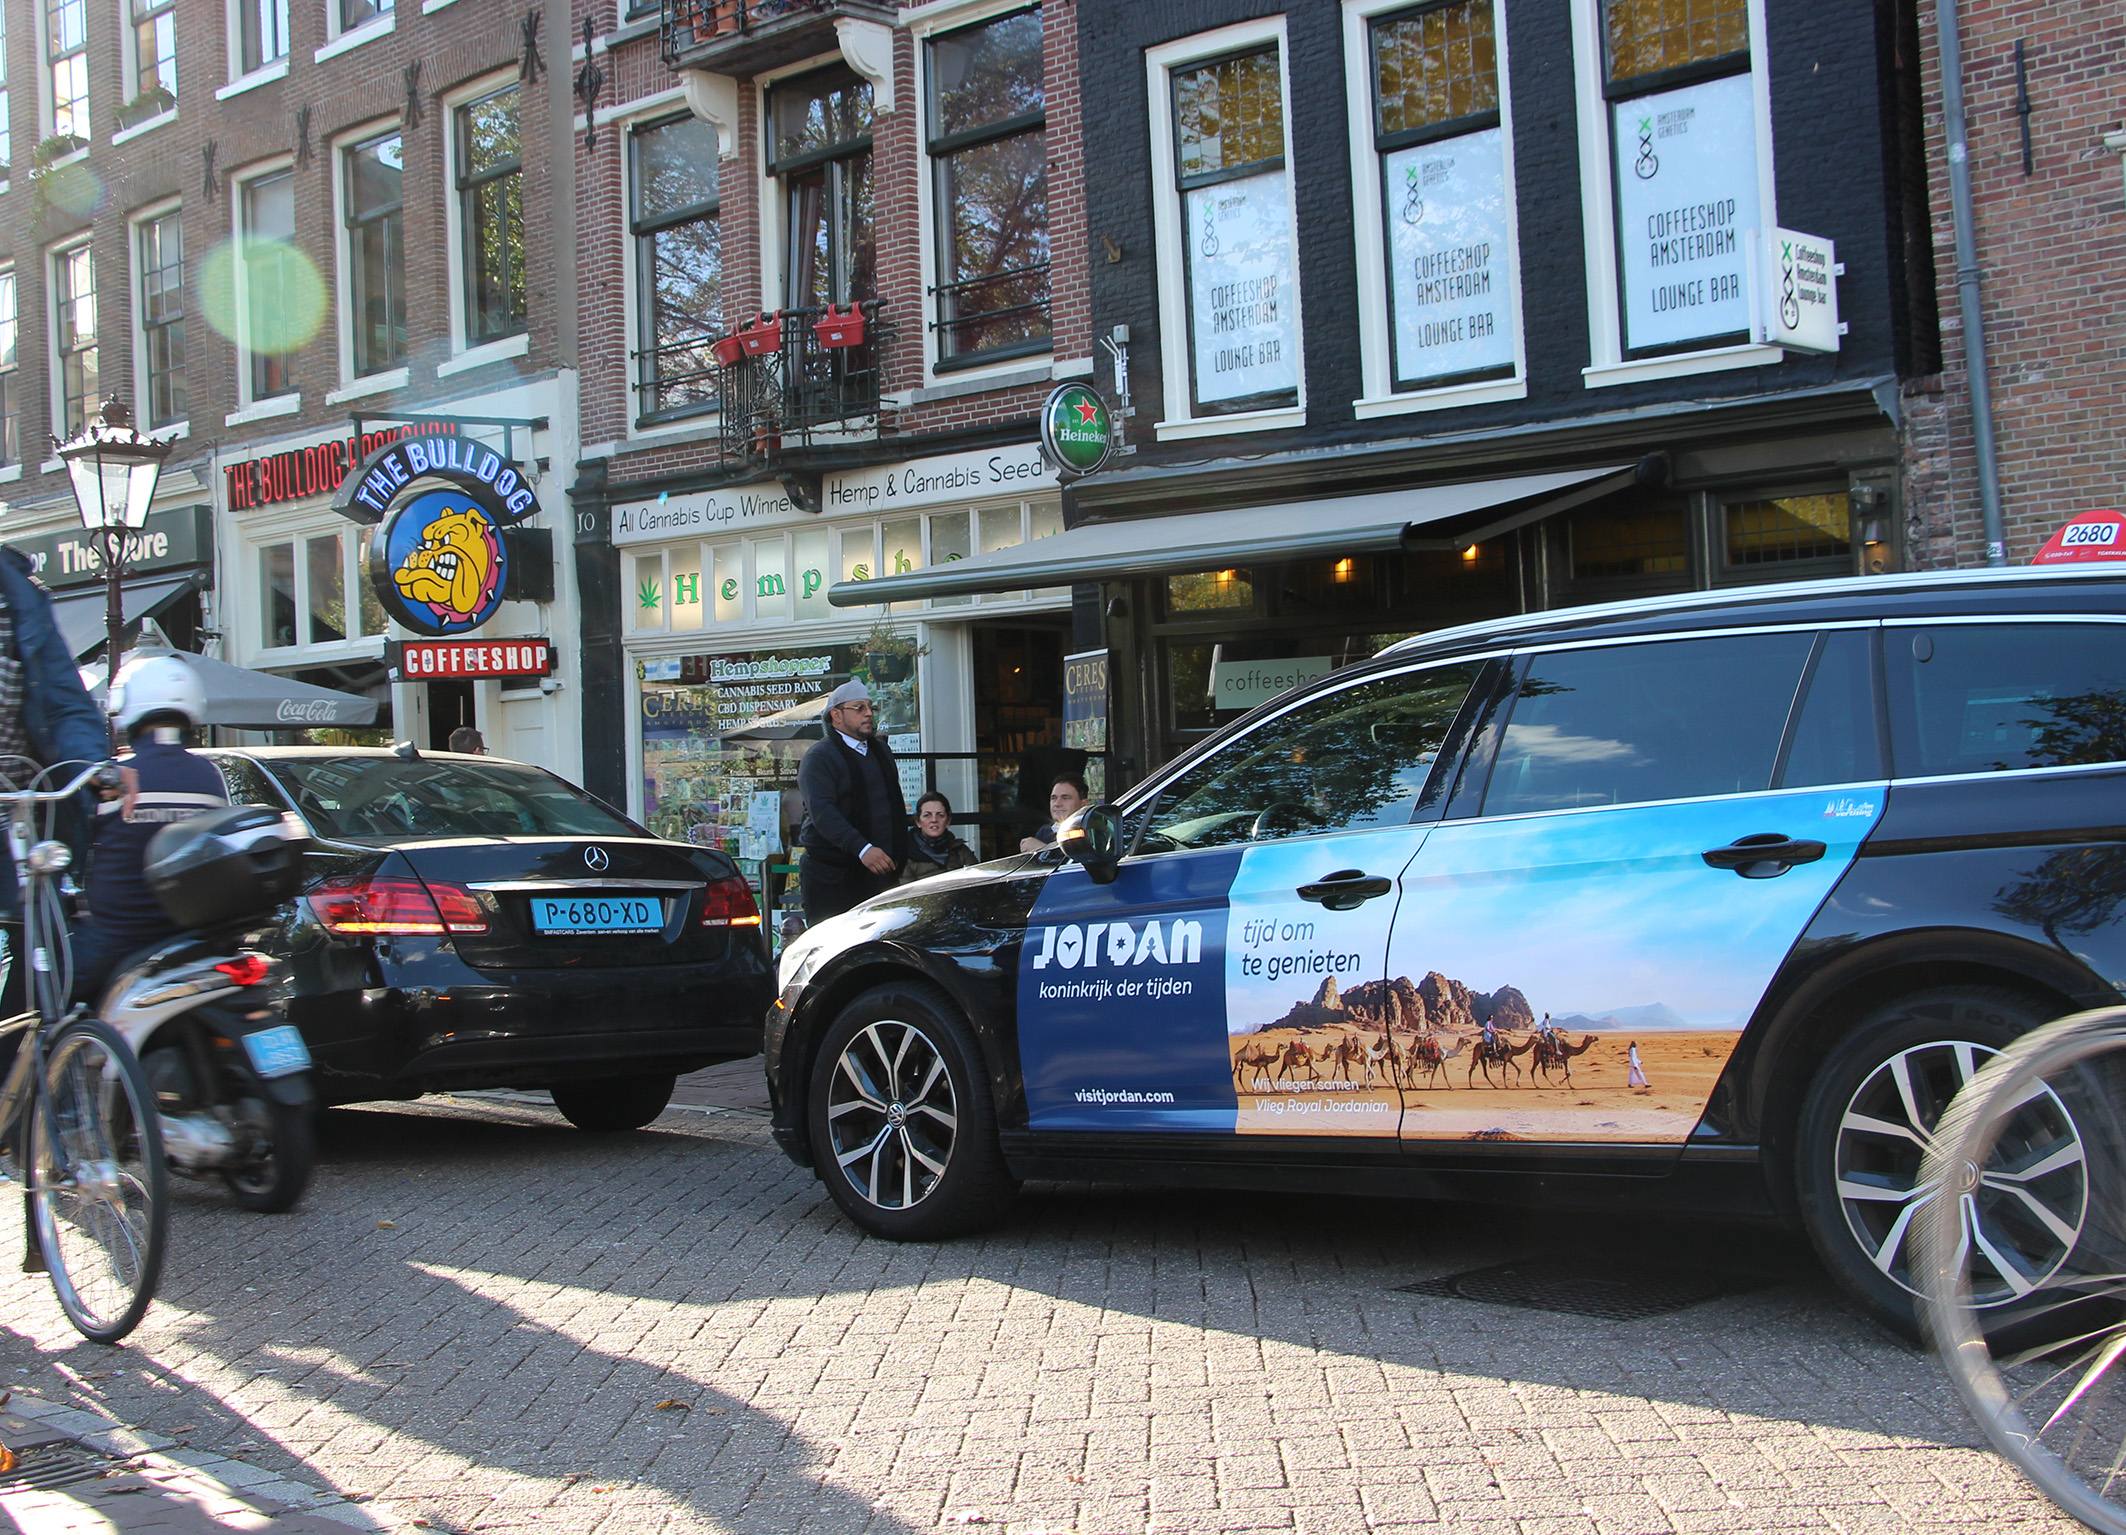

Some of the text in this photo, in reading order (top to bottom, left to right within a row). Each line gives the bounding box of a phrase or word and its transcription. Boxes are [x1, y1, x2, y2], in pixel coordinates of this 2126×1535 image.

[1657, 108, 1695, 126] AMSTERDAM
[1658, 122, 1688, 139] GENETICS
[1648, 198, 1735, 240] COFFEESHOP
[1414, 243, 1489, 280] COFFEESHOP
[1651, 228, 1736, 268] AMSTERDAM
[1211, 275, 1277, 310] COFFEESHOP
[1417, 270, 1490, 306] AMSTERDAM
[1652, 273, 1739, 313] LOUNGE BAR
[1213, 301, 1278, 334] AMSTERDAM
[1419, 312, 1494, 348] LOUNGE BAR
[1215, 339, 1281, 373] LOUNGE BAR
[1060, 427, 1108, 444] Heineke
[223, 457, 257, 511] THE
[259, 441, 342, 506] BULLDOG
[356, 436, 533, 514] THE BULLDOG
[830, 480, 880, 506] Hemp
[886, 474, 898, 497] &
[904, 467, 981, 494] Cannabis
[619, 510, 634, 534] All
[639, 507, 701, 530] Cannabis
[706, 497, 736, 525] Cup
[2066, 525, 2114, 544] 2680
[58, 540, 103, 574] The
[108, 530, 168, 567] Store
[406, 644, 548, 674] COFFEESHOP
[710, 656, 832, 682] Hempshopper
[717, 680, 822, 699] CANNABIS SEED BANK
[1065, 661, 1105, 695] CERES
[276, 698, 337, 722] Coca-Cola
[718, 699, 799, 715] CBD DISPENSARY
[718, 718, 746, 731] HEMP
[545, 902, 649, 925] P-680-XD
[1244, 918, 1315, 949] tijd om
[1242, 949, 1361, 981] te genieten
[1039, 977, 1193, 1001] koninkrijk der tijden
[1074, 1088, 1176, 1106] visitjordan.com
[1251, 1078, 1359, 1094] Wij vliegen samen
[1255, 1098, 1389, 1114] Vlieg Royal Jordanian
